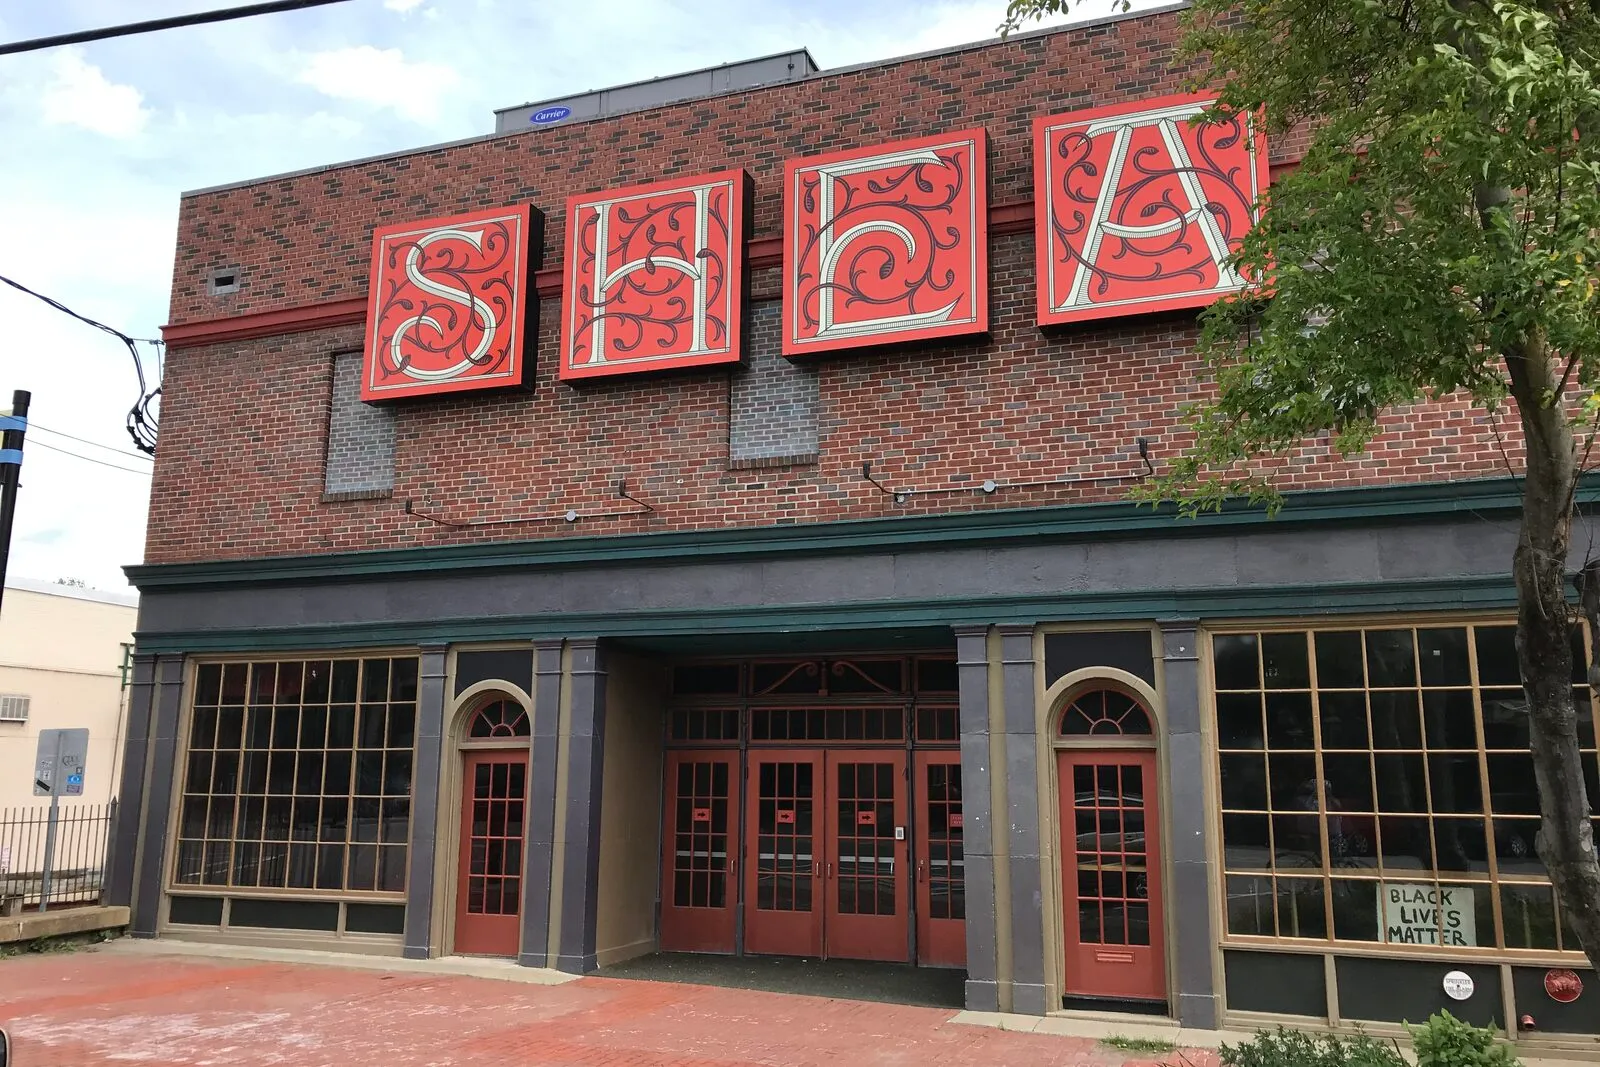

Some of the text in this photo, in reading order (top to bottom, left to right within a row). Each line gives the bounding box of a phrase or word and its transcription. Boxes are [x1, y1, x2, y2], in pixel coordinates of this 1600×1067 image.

[535, 109, 566, 121] Carrier
[1390, 889, 1452, 906] BLACK
[1400, 905, 1461, 928] LIVES
[1388, 925, 1467, 946] MATTER
